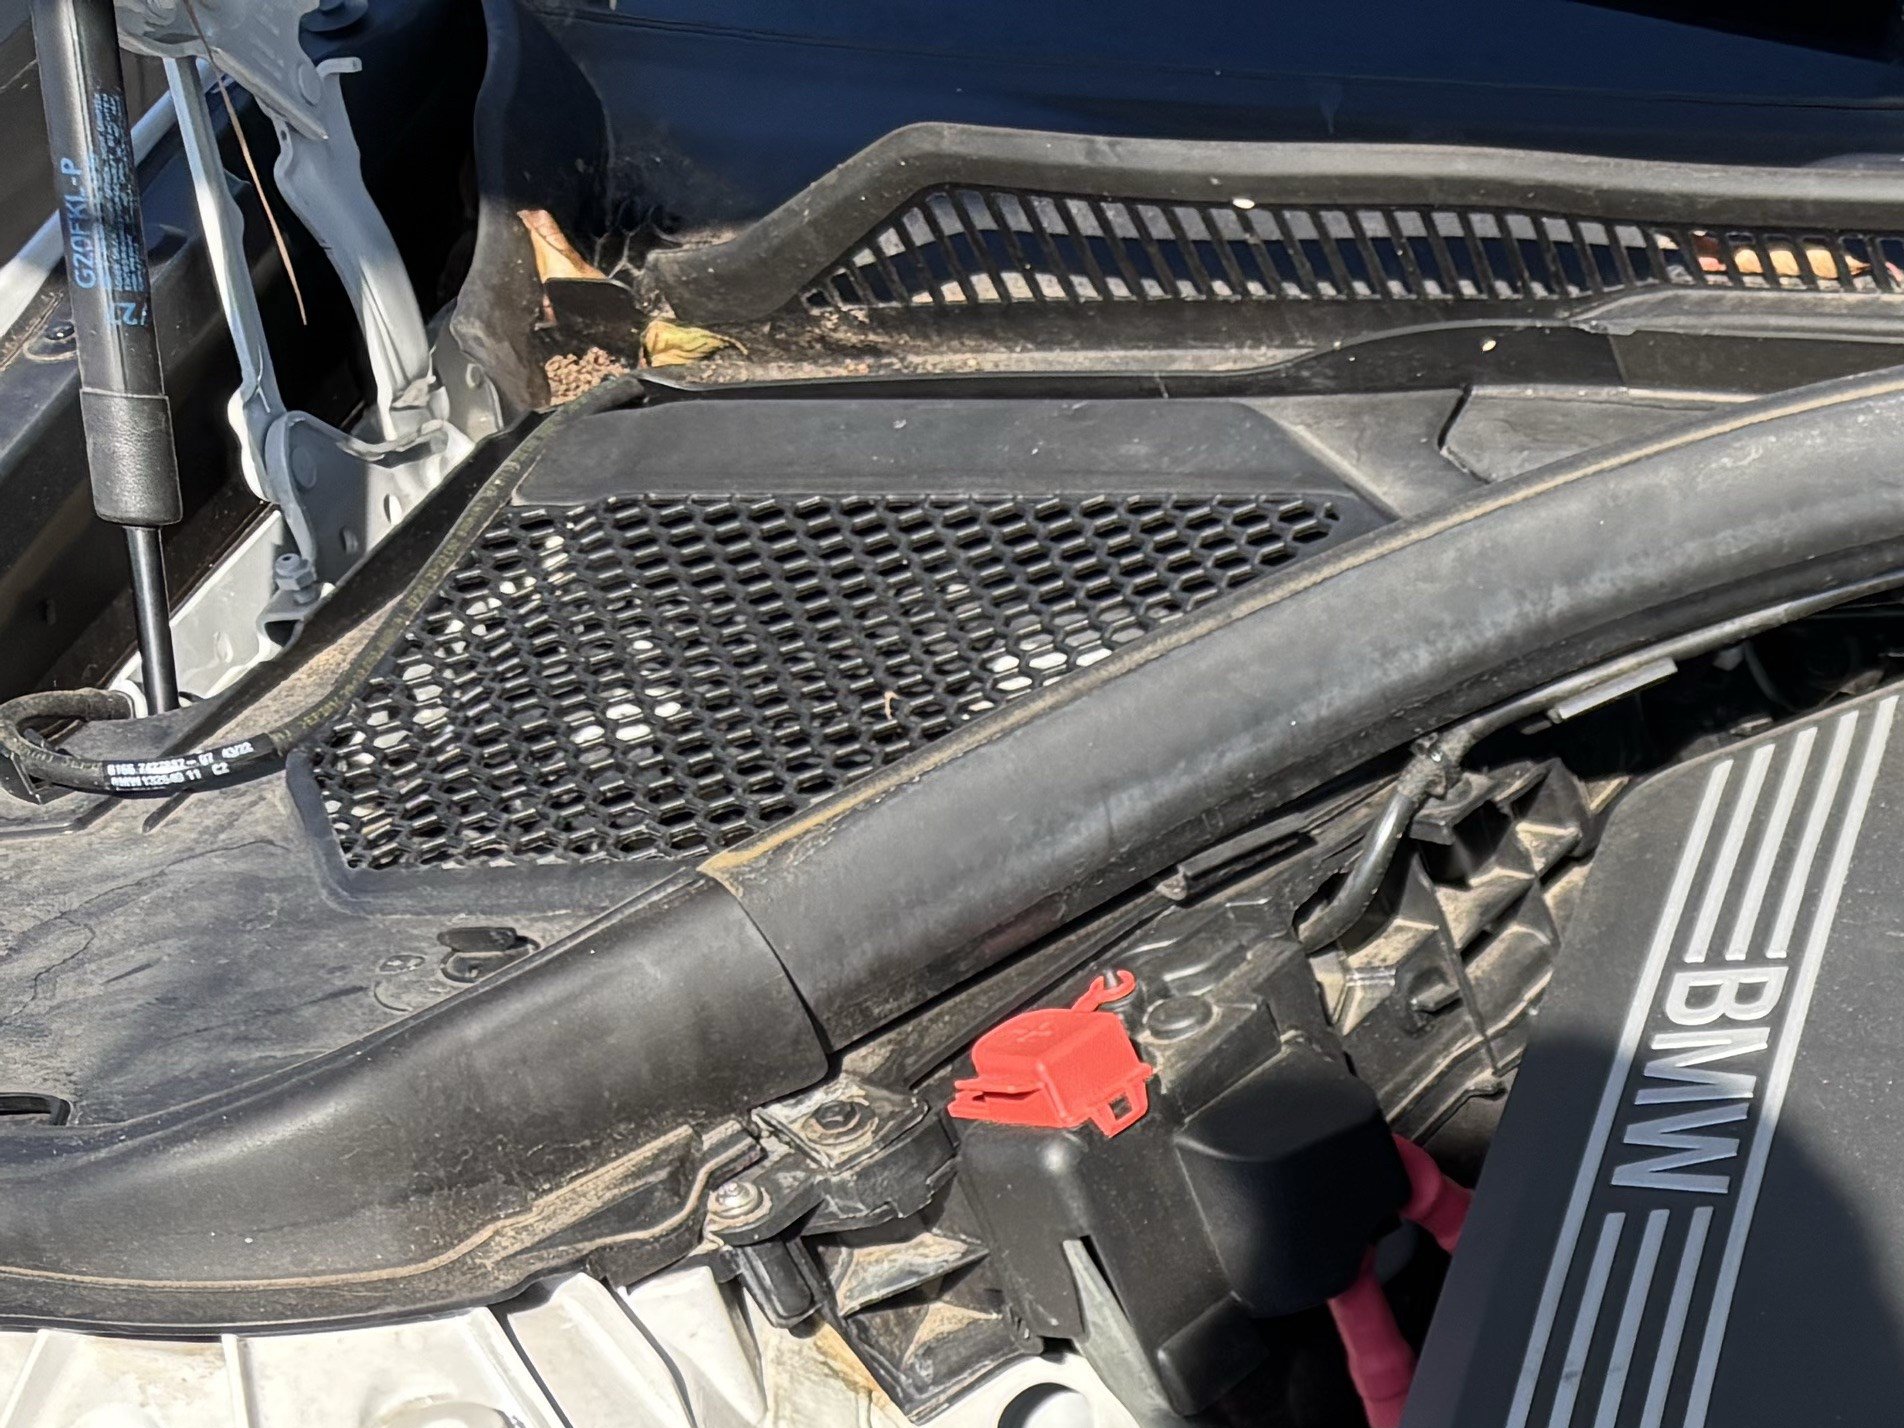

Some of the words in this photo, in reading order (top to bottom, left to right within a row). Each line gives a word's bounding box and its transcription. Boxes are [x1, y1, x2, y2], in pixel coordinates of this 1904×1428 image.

[59, 156, 97, 289] G20FKL-P
[211, 762, 230, 776] C2
[1611, 965, 1788, 1194] BMW
